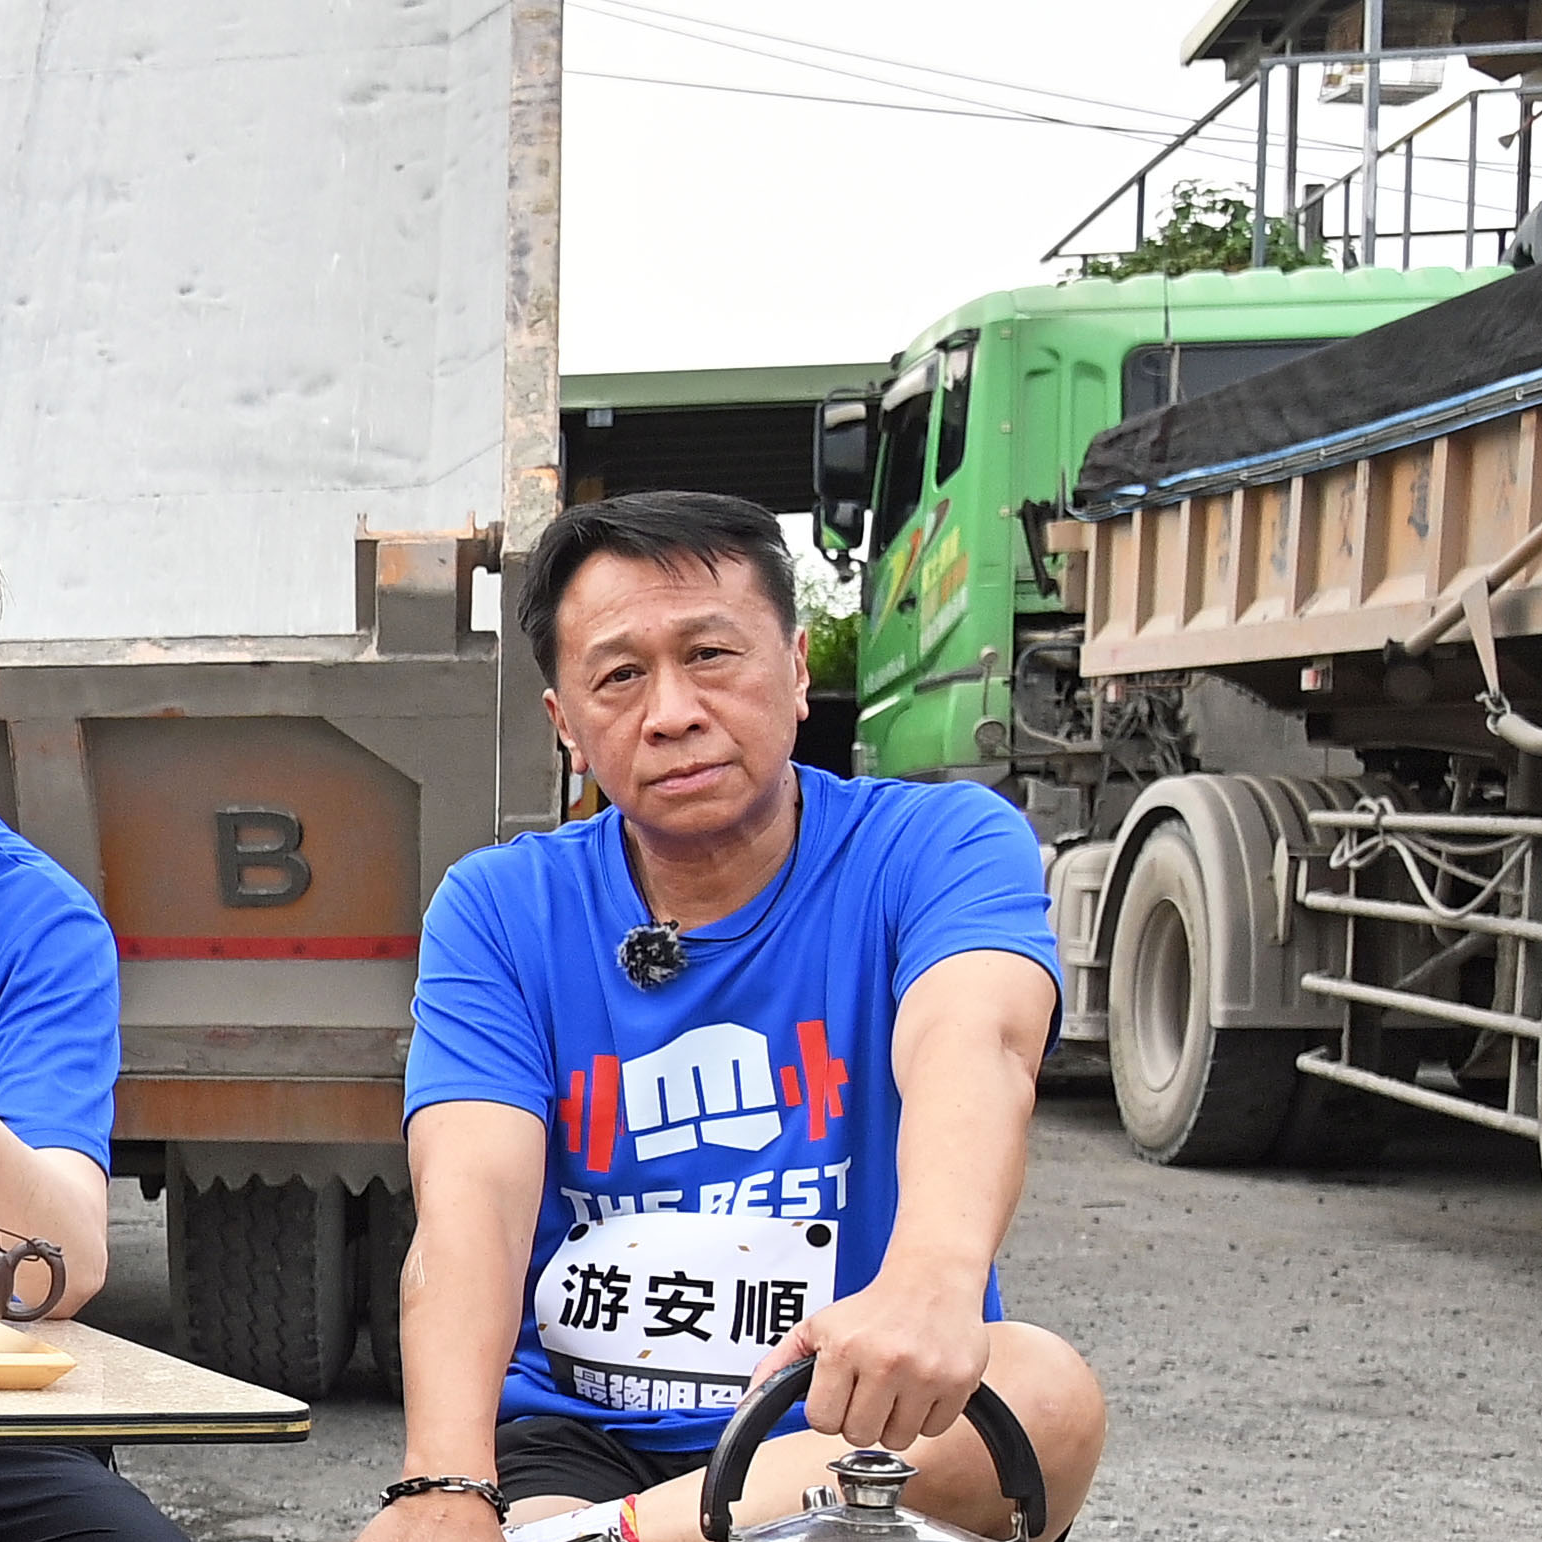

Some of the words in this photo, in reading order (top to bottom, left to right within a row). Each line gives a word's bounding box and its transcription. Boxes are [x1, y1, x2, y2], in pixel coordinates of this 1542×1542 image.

[215, 808, 312, 908] B
[699, 1156, 852, 1217] BEST
[558, 1263, 809, 1347] 游安順
